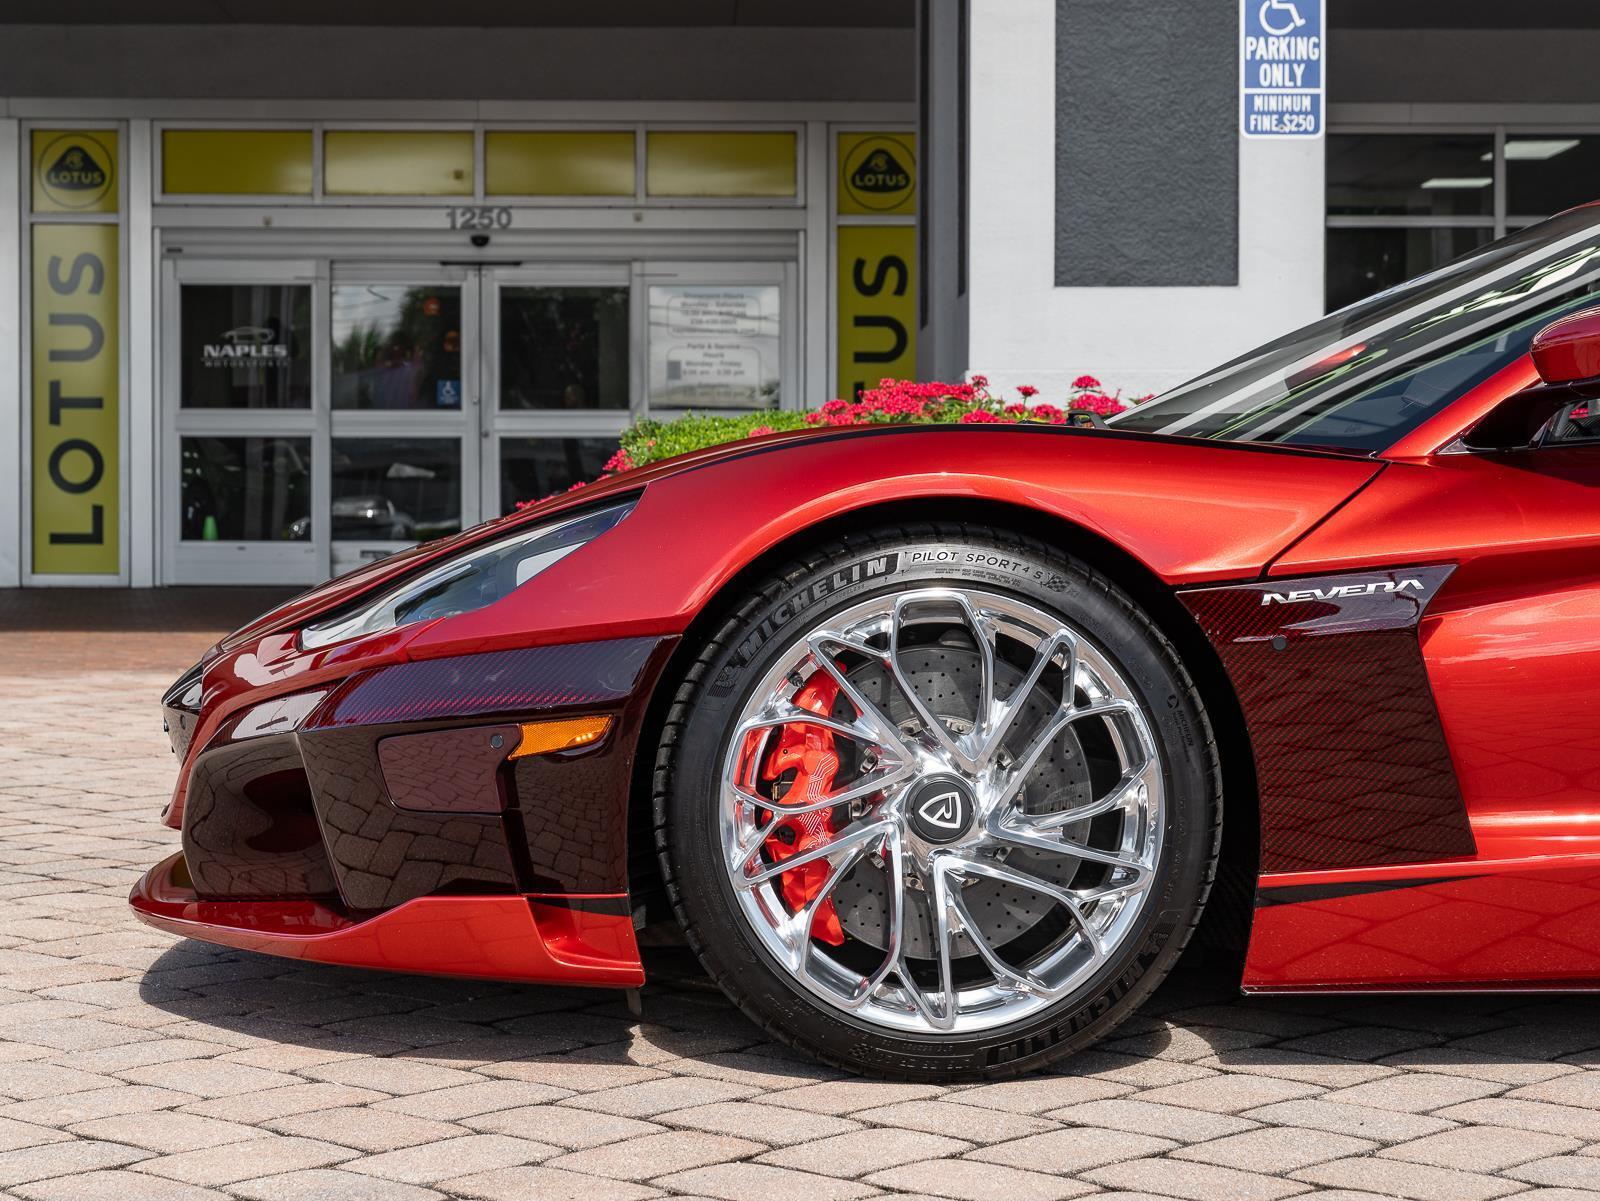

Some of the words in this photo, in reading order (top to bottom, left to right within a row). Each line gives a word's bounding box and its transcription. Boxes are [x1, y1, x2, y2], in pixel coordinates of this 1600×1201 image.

[1245, 36, 1320, 60] PARKING
[1259, 63, 1306, 87] ONLY
[1253, 94, 1312, 112] MINIMUM
[1249, 114, 1279, 131] FINE
[1282, 113, 1315, 133] $250
[50, 171, 103, 185] LOTUS
[855, 174, 907, 187] LOTUS
[446, 206, 513, 231] 1250
[203, 344, 288, 357] NAPLES
[47, 252, 105, 545] LOTUS
[912, 551, 959, 563] PILOT
[965, 553, 1022, 571] SPORT
[1033, 570, 1043, 580] S
[1261, 579, 1425, 606] NEVERA
[738, 557, 888, 662] MICHELIN
